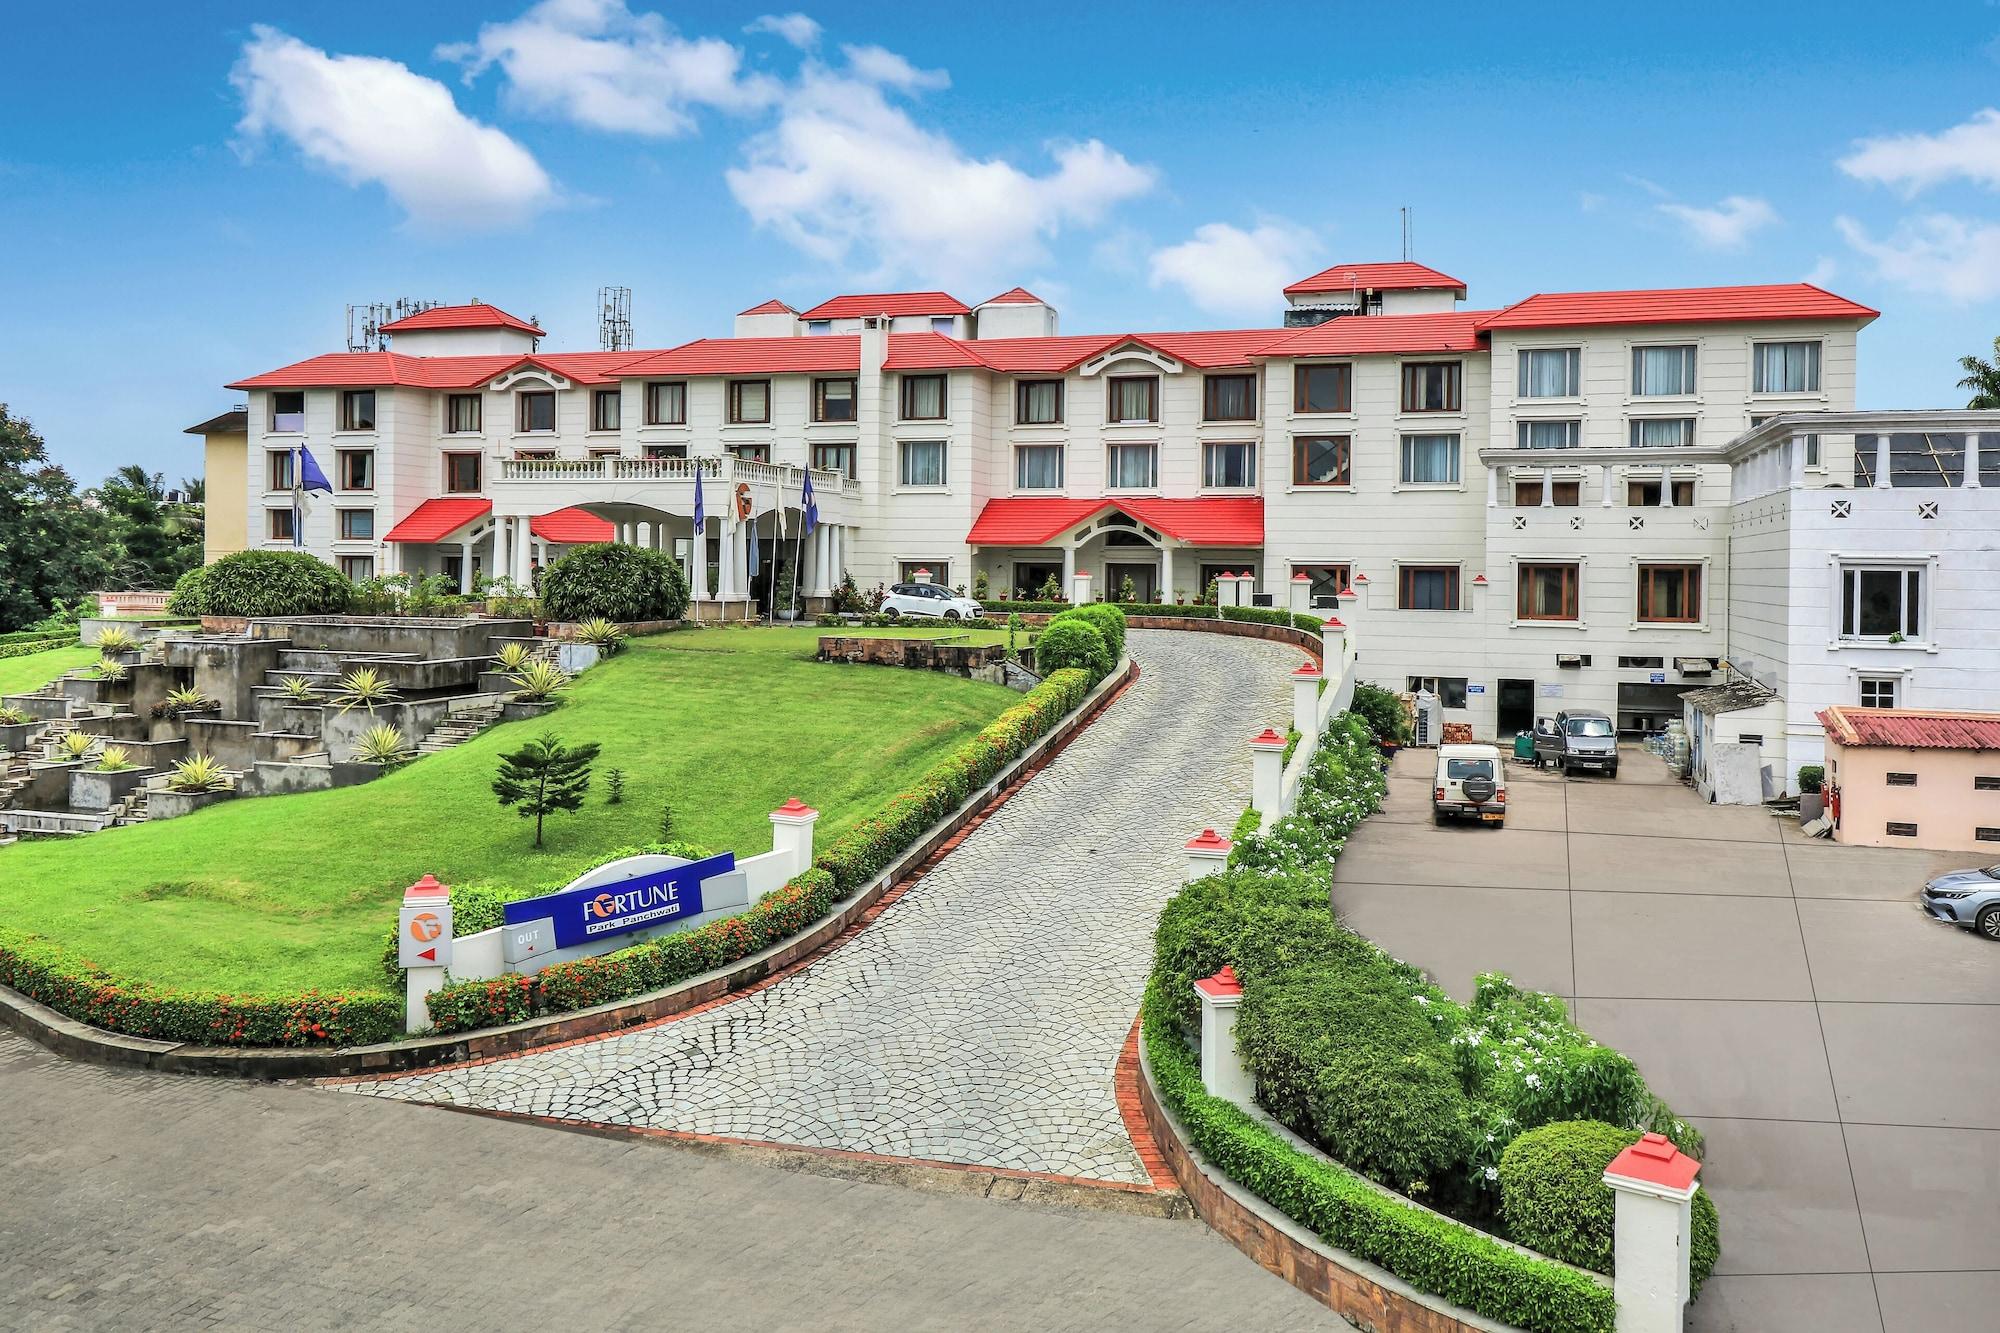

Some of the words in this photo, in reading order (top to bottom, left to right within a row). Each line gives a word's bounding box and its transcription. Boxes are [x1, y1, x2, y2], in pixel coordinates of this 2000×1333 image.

[583, 881, 678, 921] FORTUNE
[589, 921, 616, 933] Park
[622, 905, 678, 926] Panchwati
[518, 930, 539, 945] OUT
